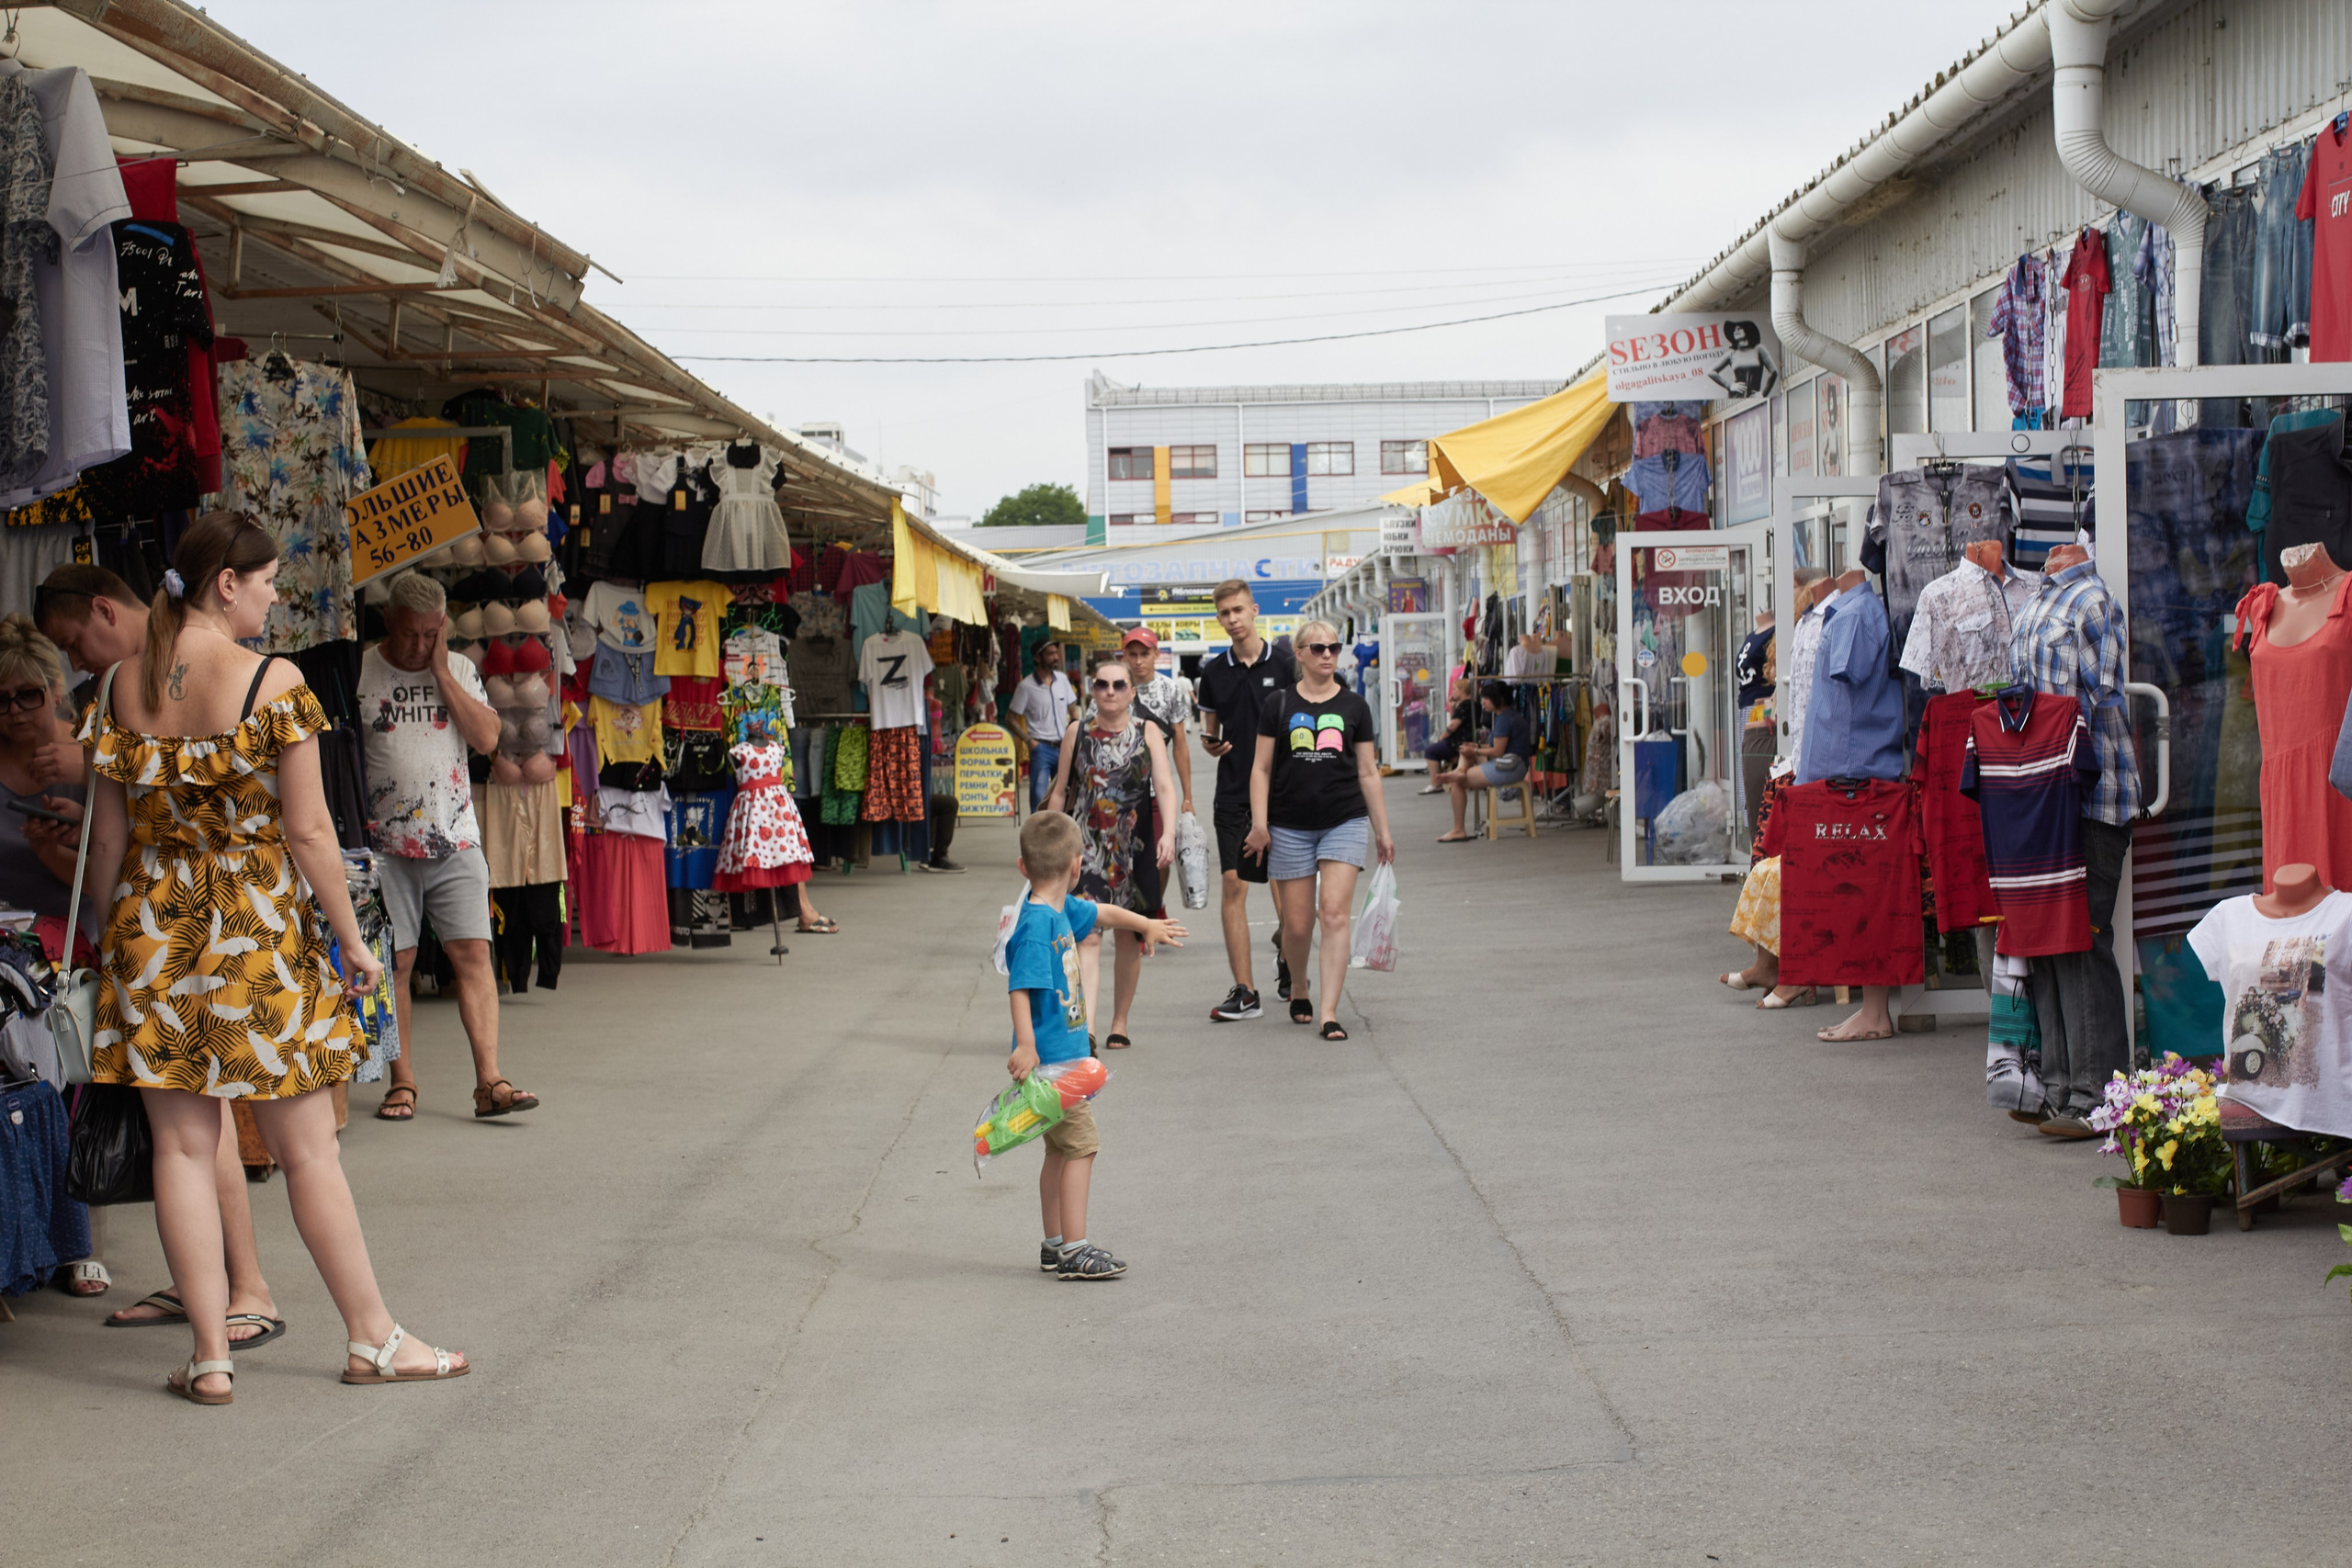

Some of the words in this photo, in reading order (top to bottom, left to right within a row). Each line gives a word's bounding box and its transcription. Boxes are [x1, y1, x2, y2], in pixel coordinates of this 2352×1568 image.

[2331, 189, 2350, 219] CITY
[120, 241, 153, 259] 75001
[1613, 365, 1652, 376] СТИЛЬНО
[1660, 356, 1691, 367] ЛЮБУЮ
[1693, 350, 1725, 361] ПОГОДУ
[1615, 367, 1704, 391] olgagalitskaya_08
[347, 461, 453, 527] ОЛЬШИЕ
[356, 483, 465, 550] АЗМЕРЫ
[1384, 519, 1417, 528] БЛУЗКИ
[1425, 502, 1491, 528] СУМК
[1384, 533, 1408, 541] ЮБКИ
[1426, 529, 1511, 545] ЧЕМОДАНЫ
[370, 526, 433, 569] 56-80
[1384, 545, 1414, 554] БРЮКИ
[1329, 558, 1362, 568] РАДУ
[1658, 586, 1720, 607] ВХОД
[876, 655, 909, 685] Z
[392, 686, 434, 703] OFF
[380, 705, 448, 723] WHITE
[959, 746, 1009, 755] ШКОЛЬНАЯ
[959, 758, 992, 766] ФОРМА
[959, 770, 1002, 778] ПЕРЧАТКИ
[959, 782, 989, 790] РЕМНИ
[959, 793, 989, 801] ЗОНТЫ
[959, 804, 1012, 813] БИЖУТЕРИЯ
[1814, 822, 1888, 840] RELAX
